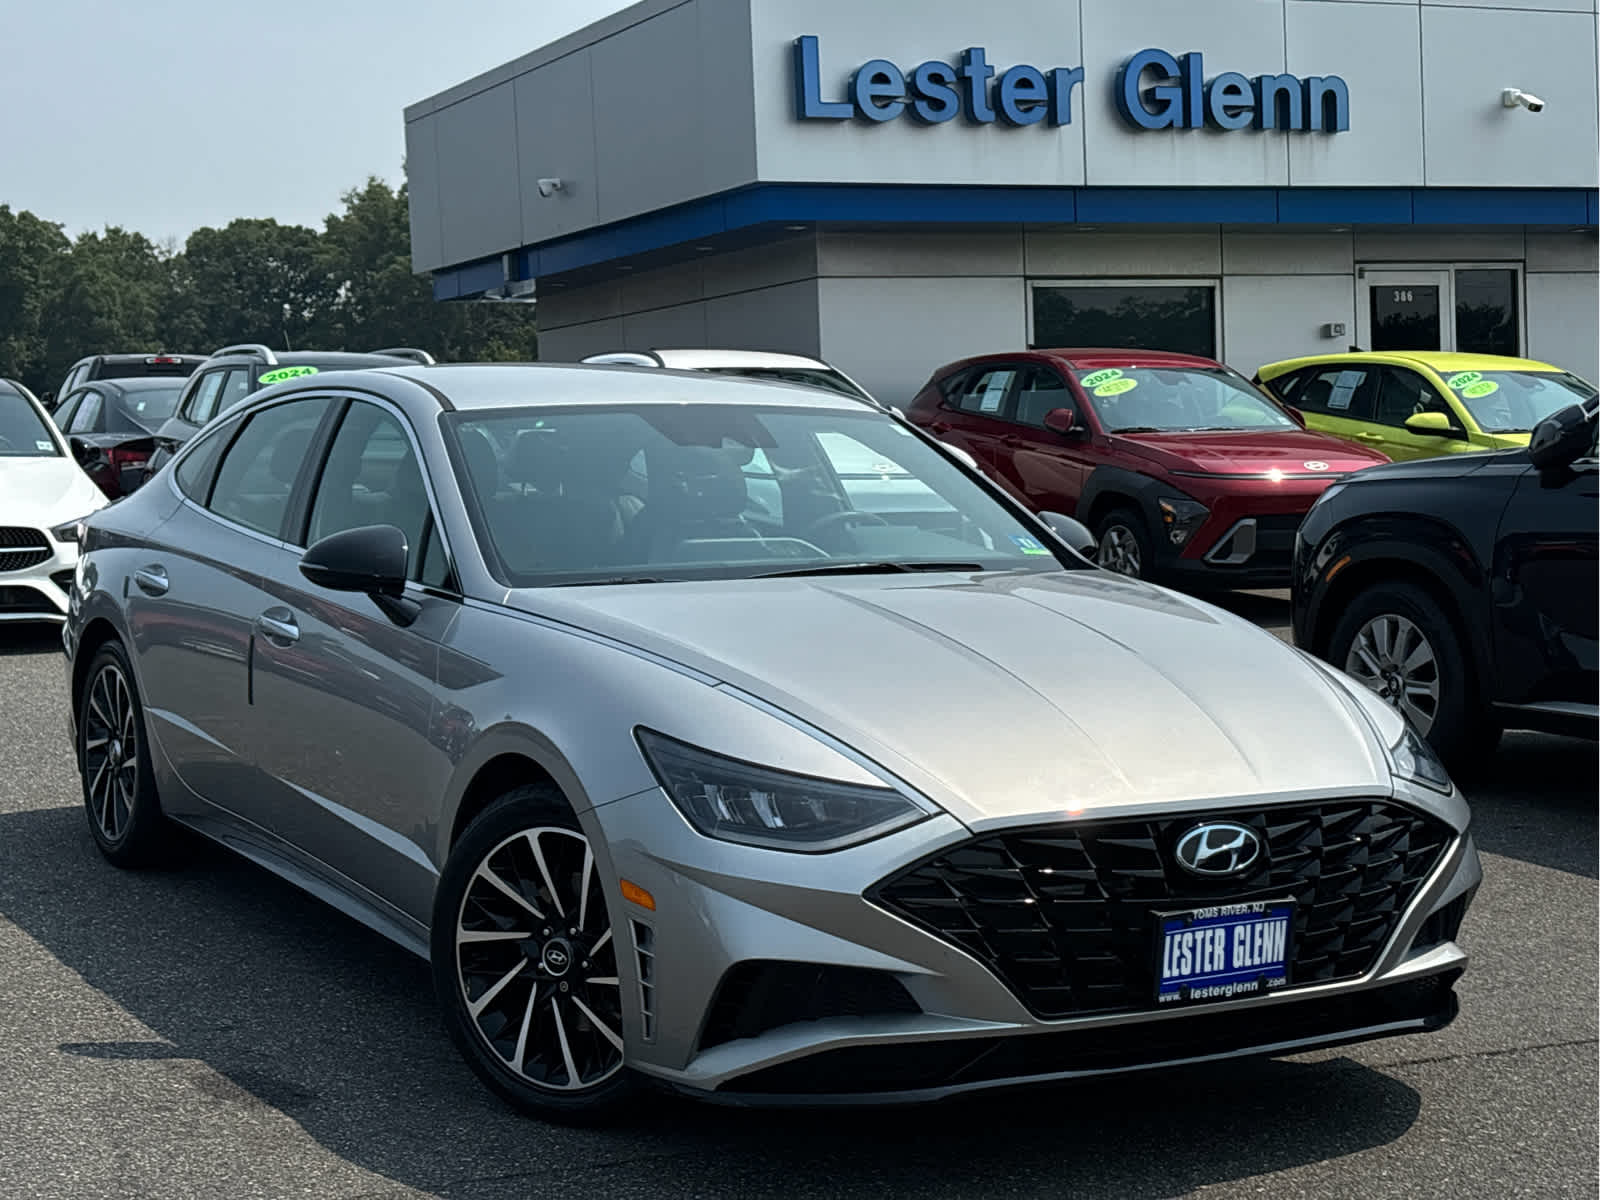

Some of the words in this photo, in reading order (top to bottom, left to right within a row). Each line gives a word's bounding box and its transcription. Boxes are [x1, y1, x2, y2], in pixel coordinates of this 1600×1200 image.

[794, 35, 1084, 127] Lester
[1116, 47, 1350, 133] Glenn
[1393, 290, 1413, 302] 386
[266, 367, 313, 383] 2024
[1086, 369, 1120, 386] 2024
[1451, 372, 1480, 387] 2024
[1193, 908, 1219, 920] TOMS
[1252, 902, 1266, 913] NJ
[1163, 927, 1226, 979] LESTER
[1232, 919, 1288, 969] GLENN
[1190, 980, 1259, 1000] lesterglenn
